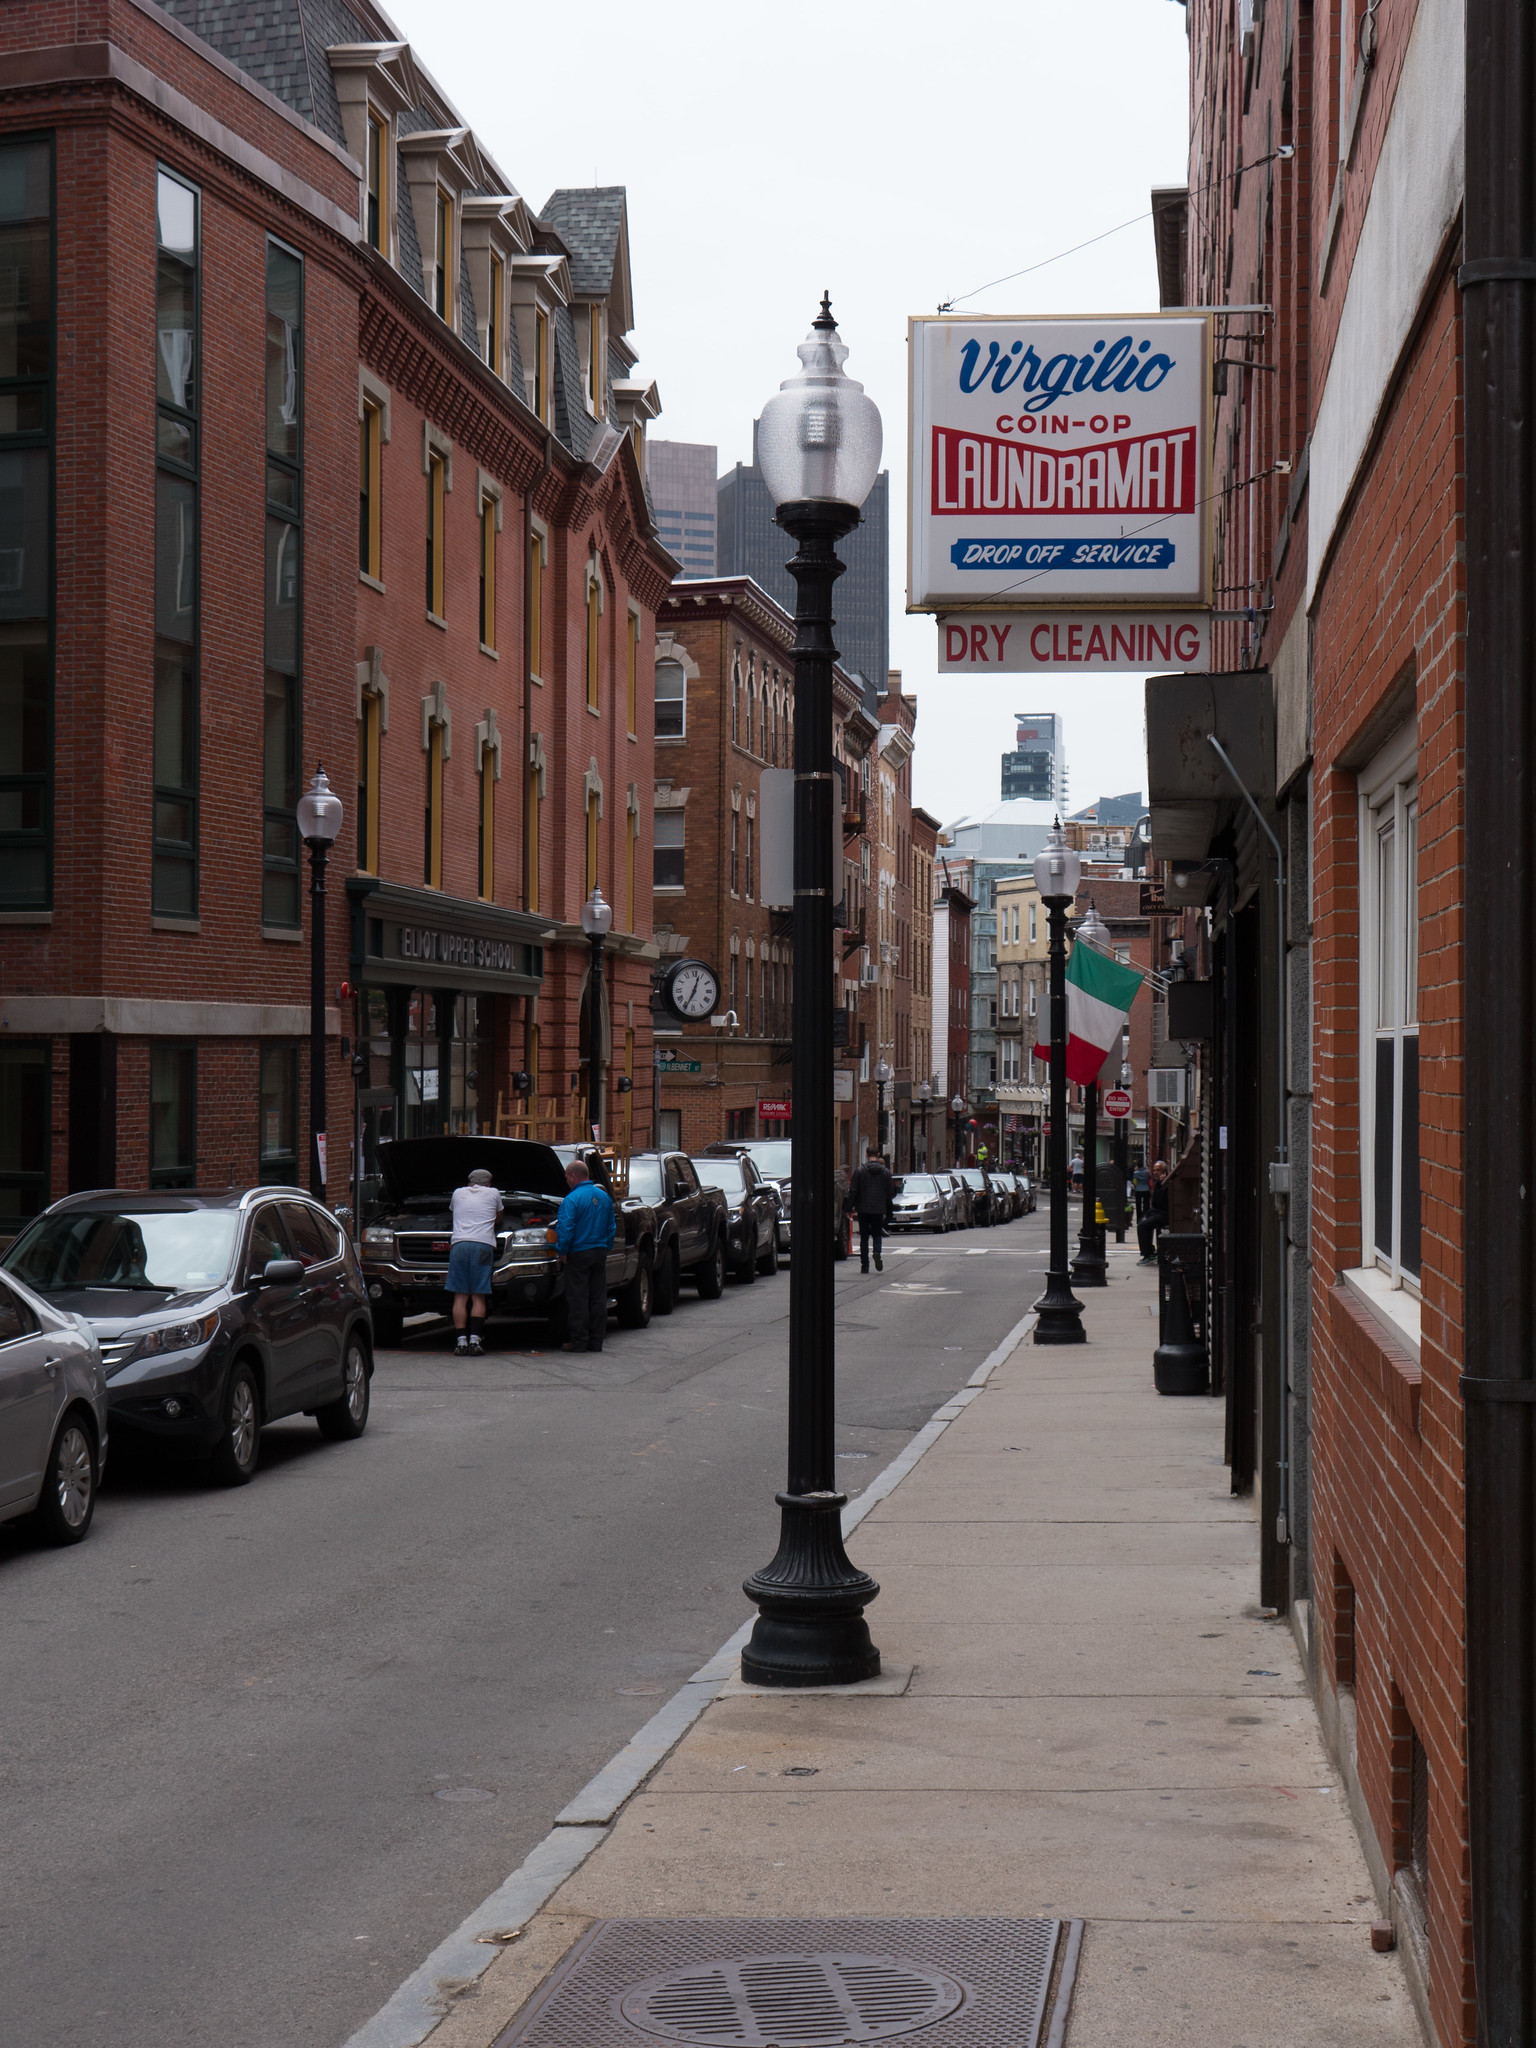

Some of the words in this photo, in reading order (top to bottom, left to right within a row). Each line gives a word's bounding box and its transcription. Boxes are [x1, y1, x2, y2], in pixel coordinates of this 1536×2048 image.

[959, 335, 1177, 413] Virgilio
[996, 414, 1132, 434] COIN-OP
[937, 431, 1191, 510] LAUNDRAMAT
[962, 544, 1024, 564] DROP
[1025, 544, 1065, 564] OFF
[1072, 544, 1164, 564] SERVICE
[946, 624, 1013, 662] DRY
[1030, 623, 1201, 662] CLEANING
[401, 927, 438, 960] ELIOT
[441, 933, 475, 965] UPPER
[478, 939, 516, 970] SCHOOL
